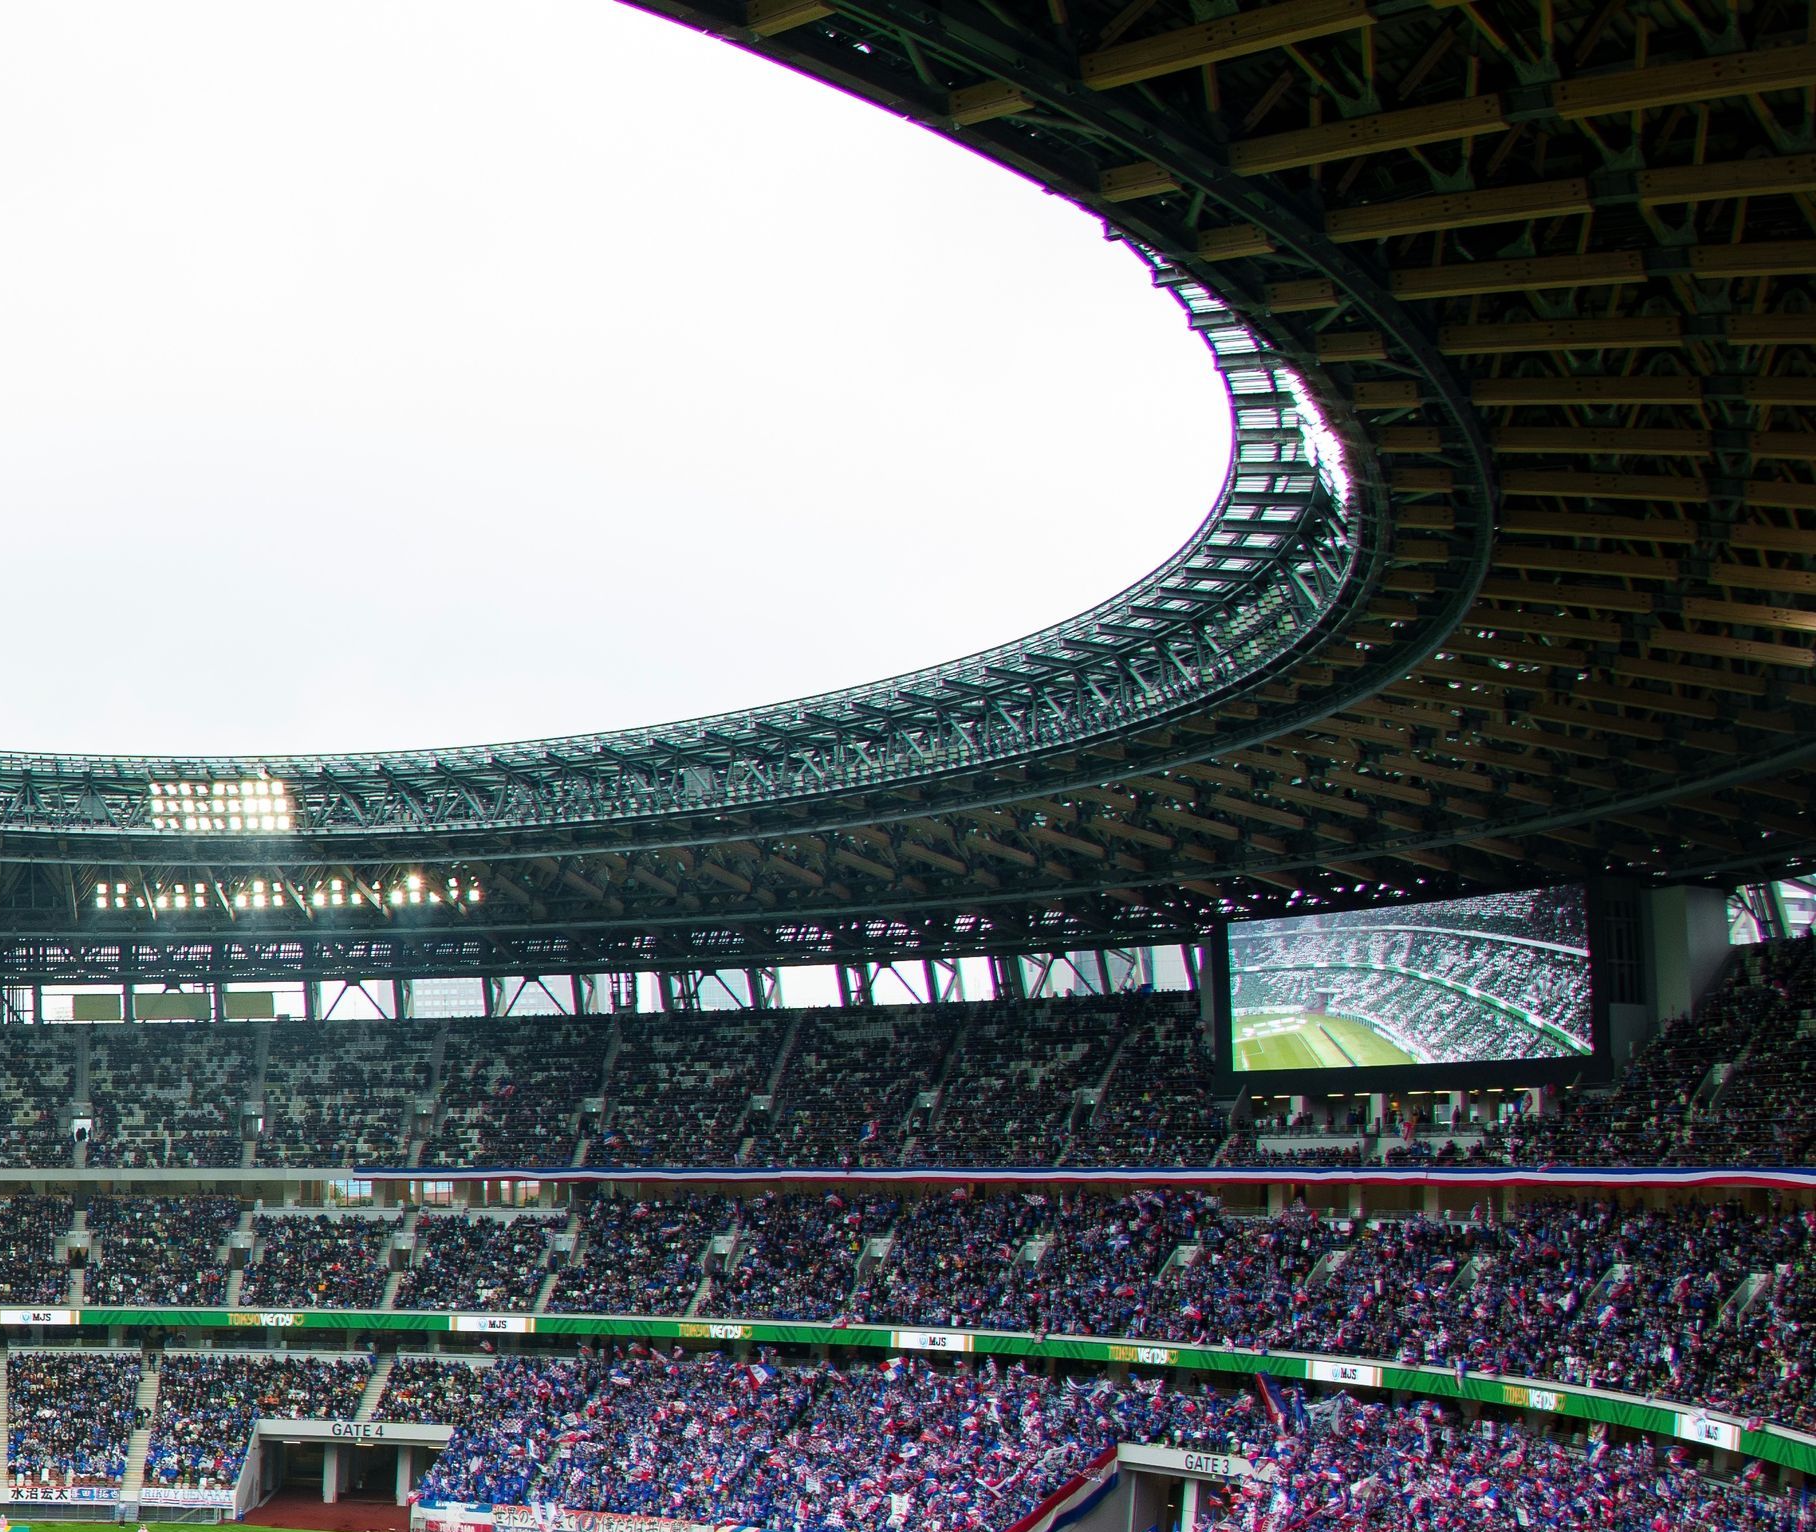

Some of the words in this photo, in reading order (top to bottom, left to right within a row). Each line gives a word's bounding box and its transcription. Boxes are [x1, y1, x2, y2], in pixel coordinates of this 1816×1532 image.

[32, 1312, 52, 1323] MJS
[488, 1318, 508, 1331] MJS
[929, 1334, 947, 1348] MJS
[1341, 1368, 1358, 1382] MJS
[332, 1423, 371, 1437] GATE
[375, 1424, 384, 1437] 4
[1185, 1454, 1219, 1473] GATE
[1223, 1459, 1229, 1474] 3
[11, 1488, 69, 1500] 水沼宏太
